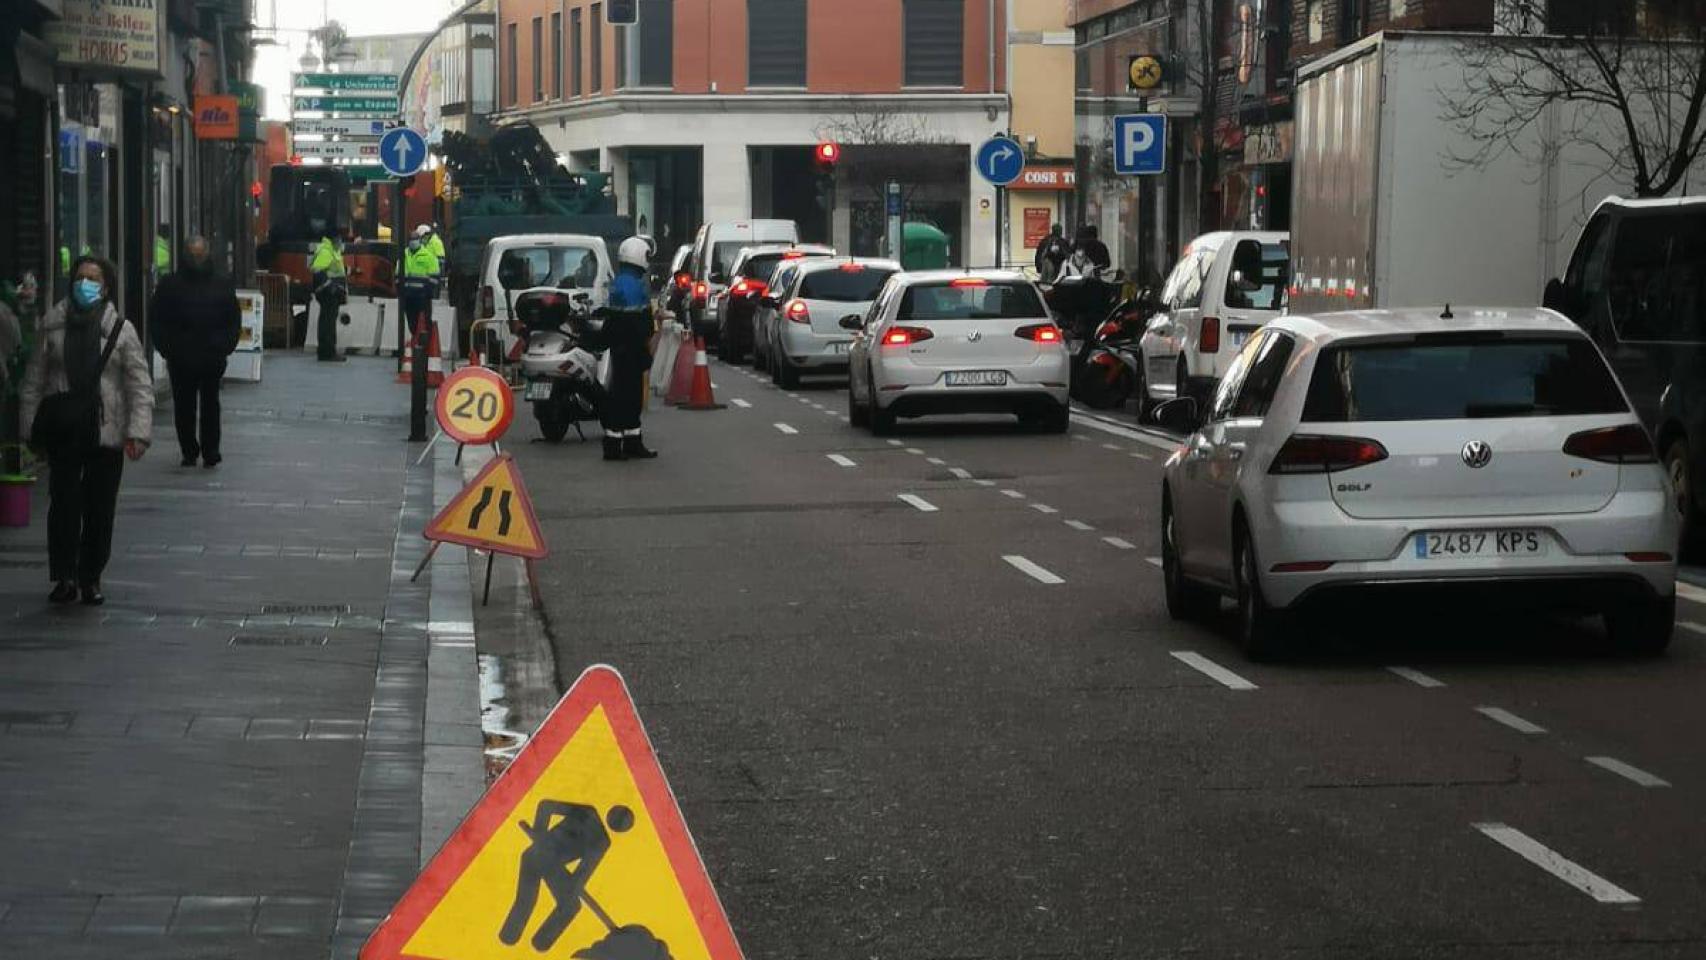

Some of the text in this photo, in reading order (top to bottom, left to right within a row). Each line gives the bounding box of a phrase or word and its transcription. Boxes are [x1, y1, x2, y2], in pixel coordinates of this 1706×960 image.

[1124, 121, 1155, 166] P
[1024, 171, 1057, 183] COSE
[452, 387, 498, 422] 20
[1336, 483, 1373, 492] GOLF
[1429, 531, 1540, 555] 2487 KPS
